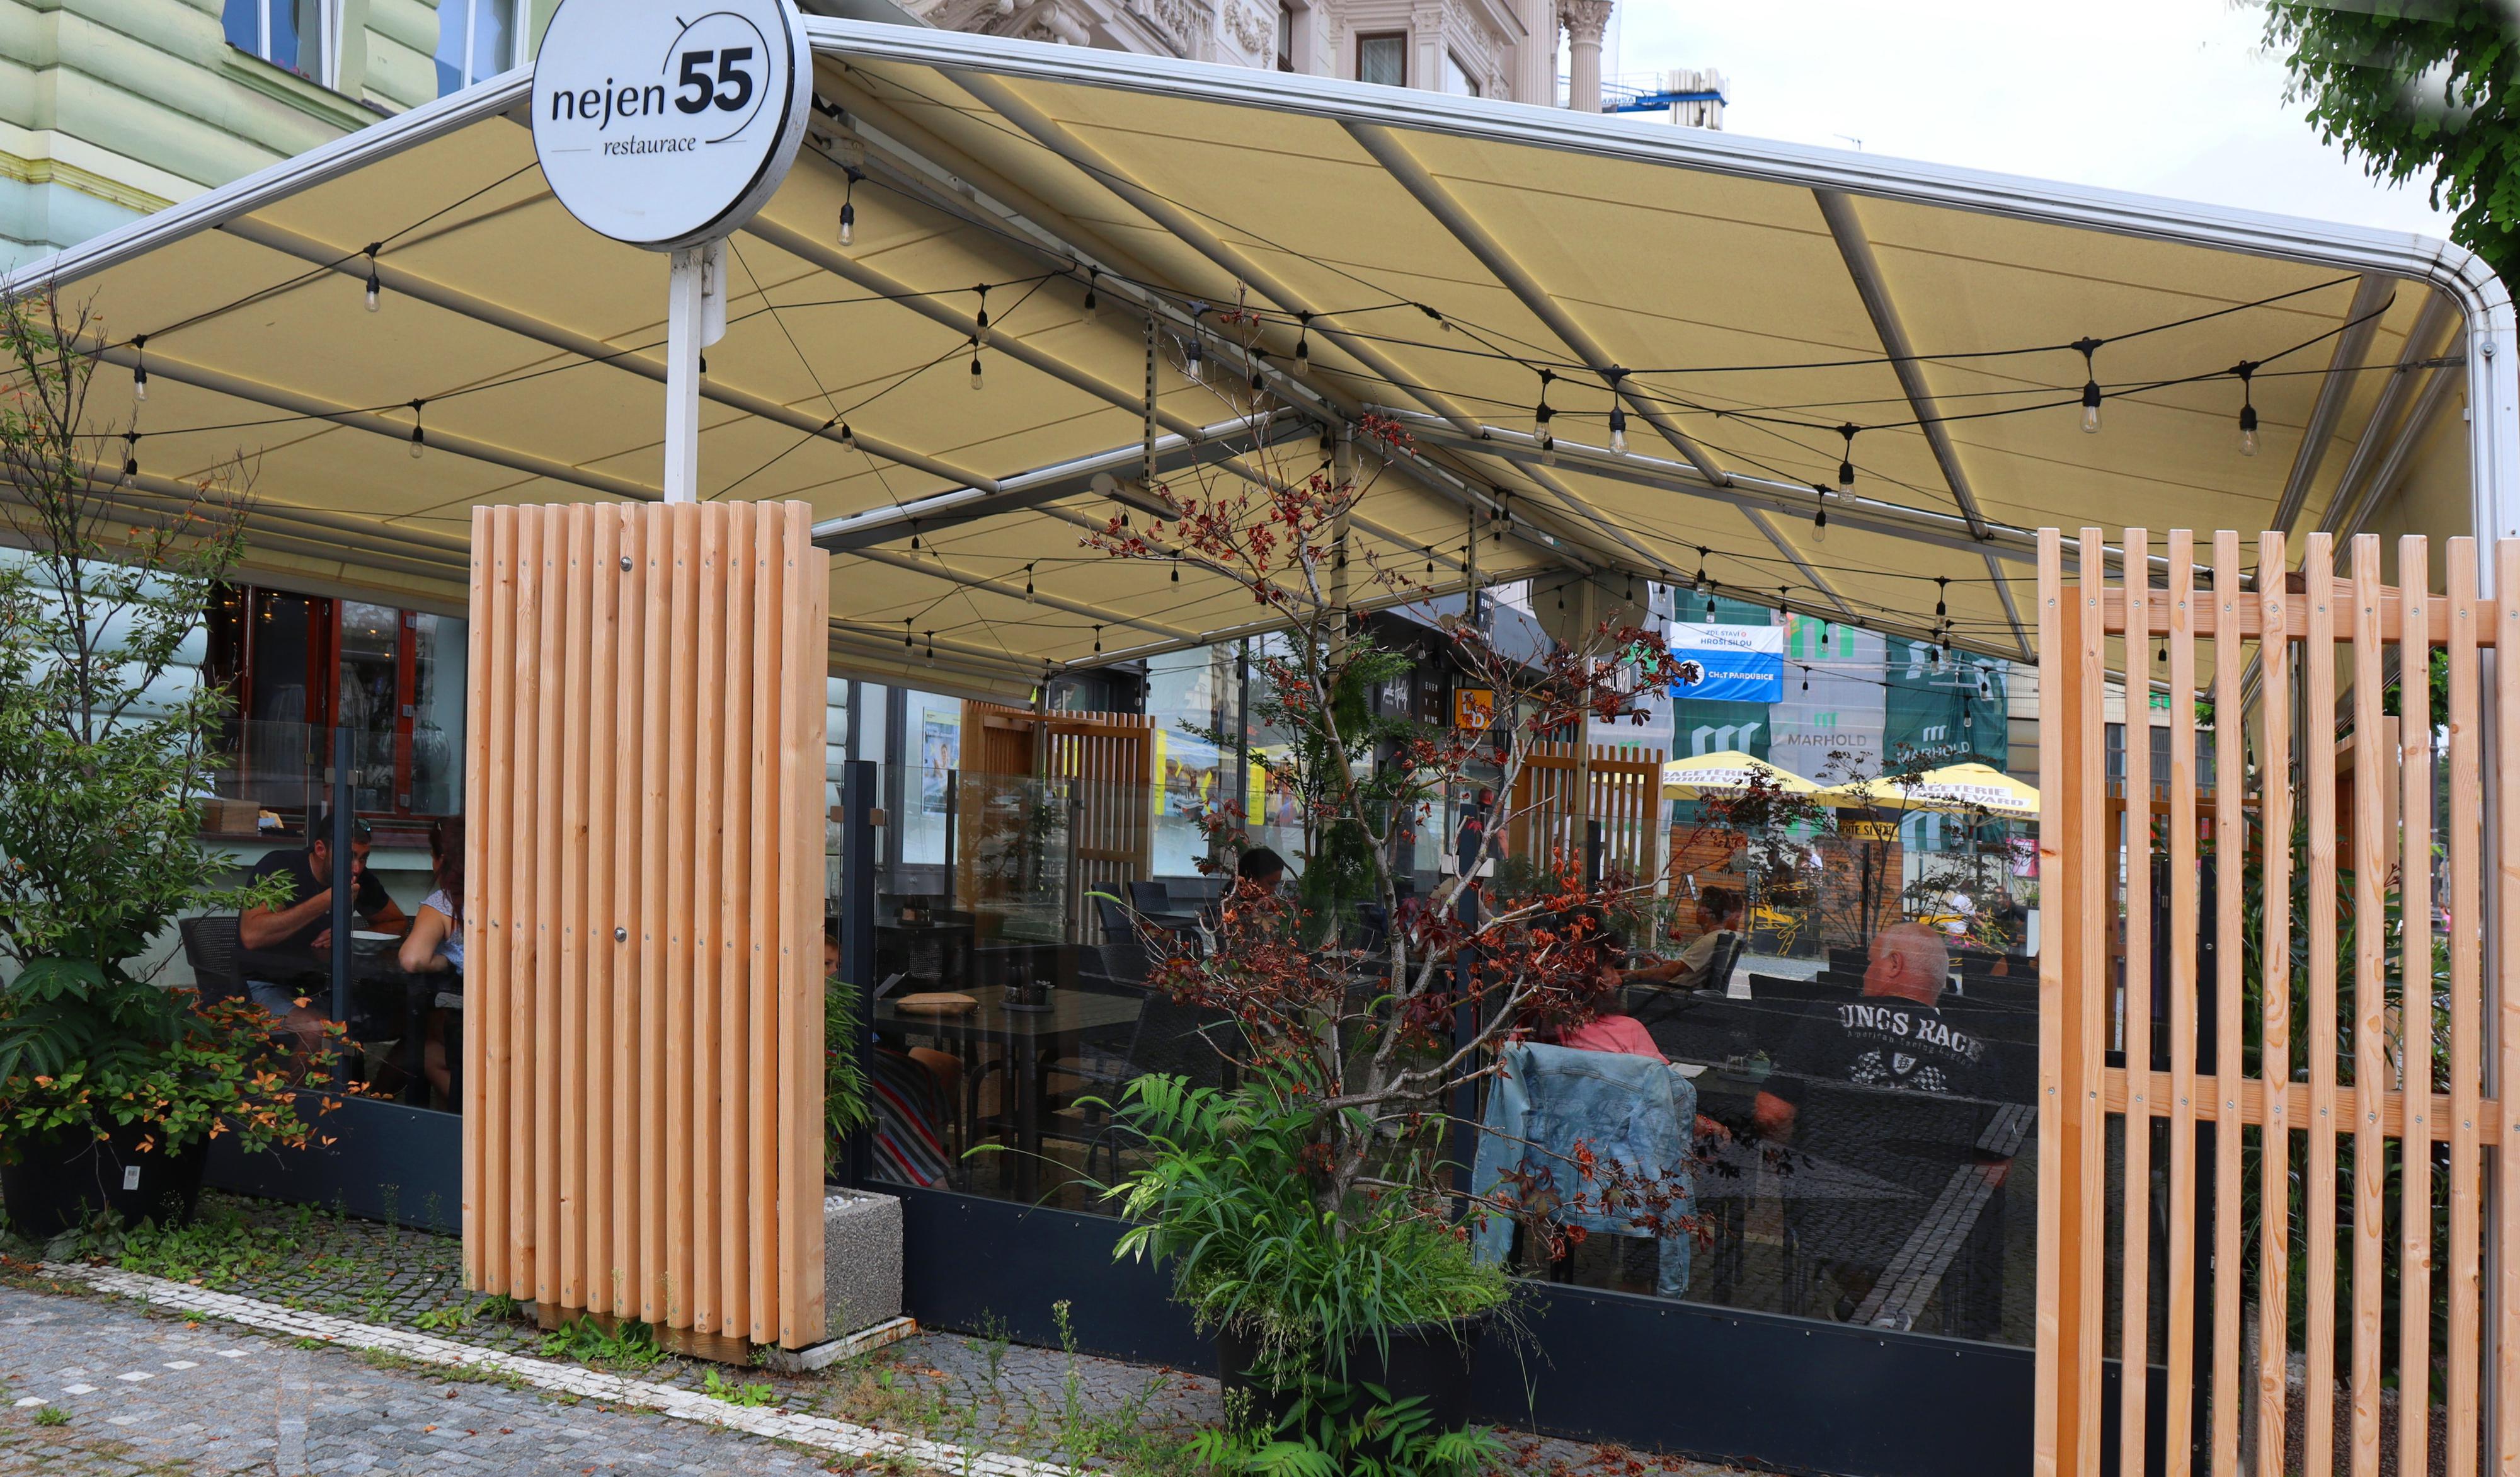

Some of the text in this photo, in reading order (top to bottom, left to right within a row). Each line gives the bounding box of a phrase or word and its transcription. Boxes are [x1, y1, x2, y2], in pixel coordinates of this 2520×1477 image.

[552, 47, 753, 131] nejen 55
[604, 135, 696, 156] restaurace
[1729, 672, 1774, 681] PARDUBICE
[1788, 734, 1867, 746] MARHOLD
